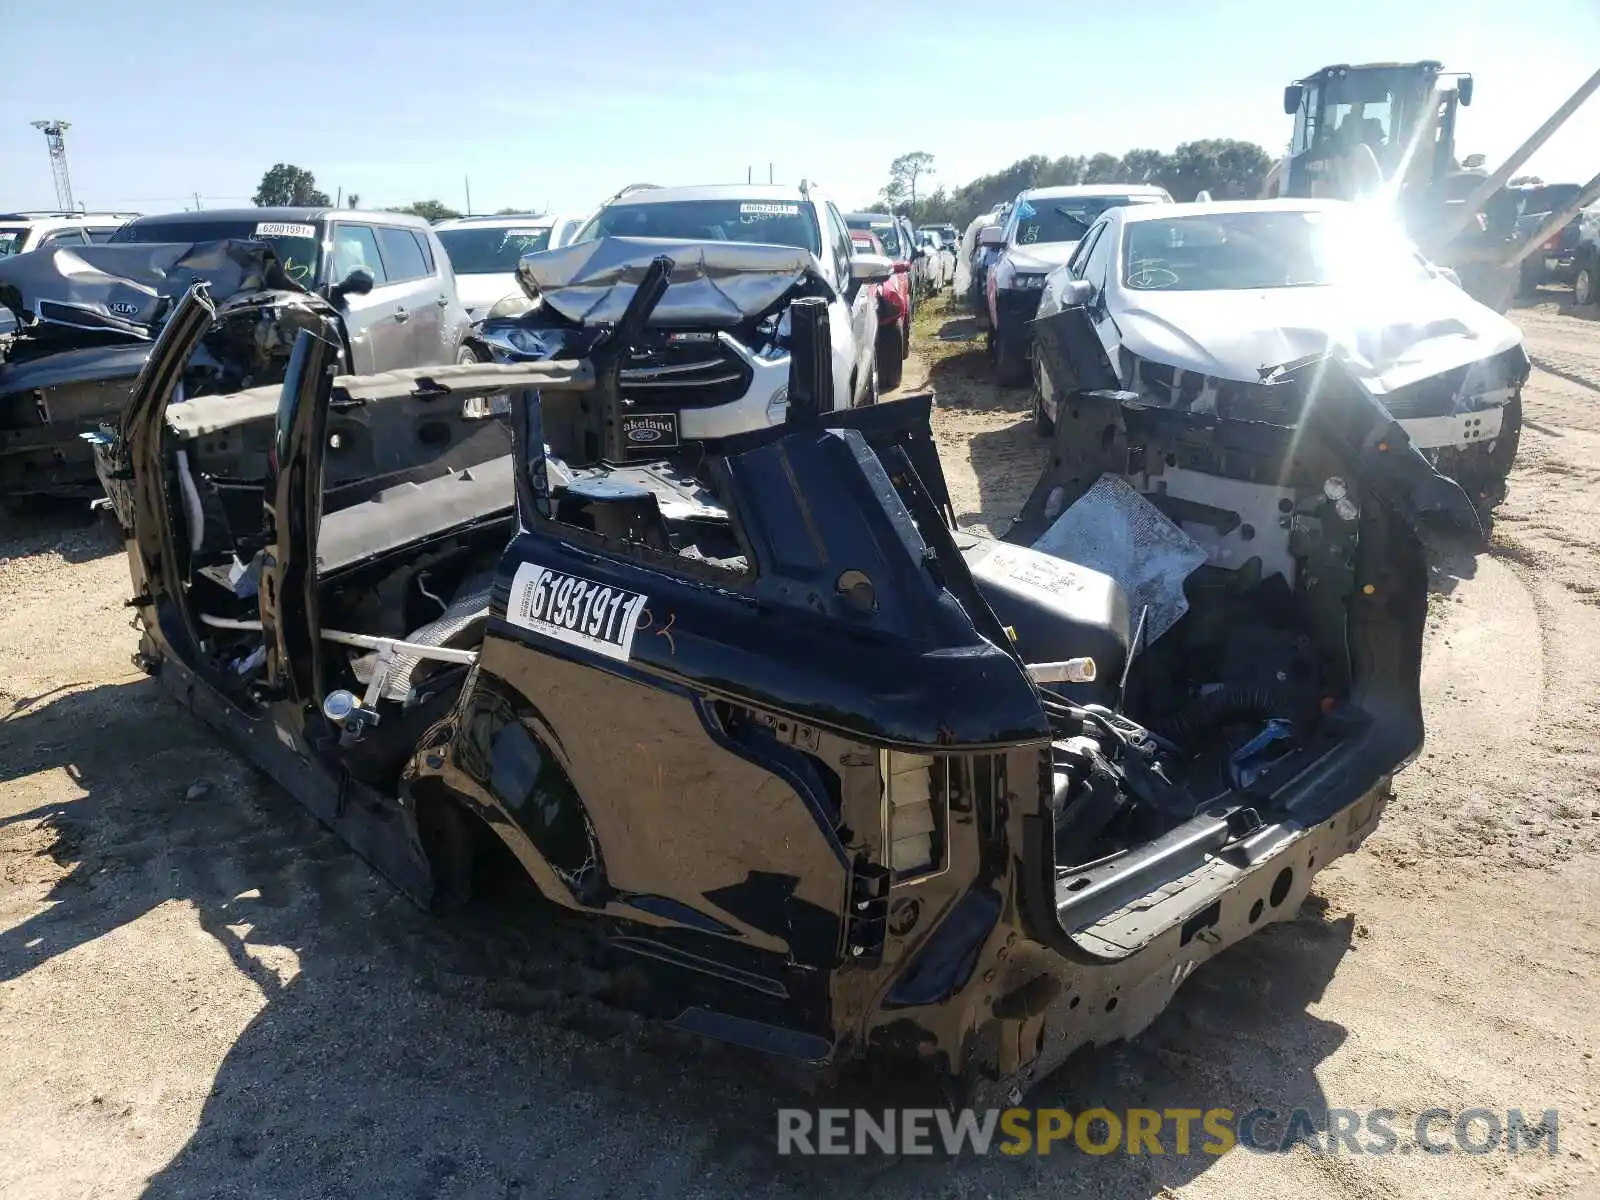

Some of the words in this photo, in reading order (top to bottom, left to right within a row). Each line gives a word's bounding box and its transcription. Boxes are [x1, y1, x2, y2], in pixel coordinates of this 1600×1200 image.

[113, 303, 136, 313] KIA
[623, 418, 673, 432] akeland
[532, 571, 638, 644] 61931911
